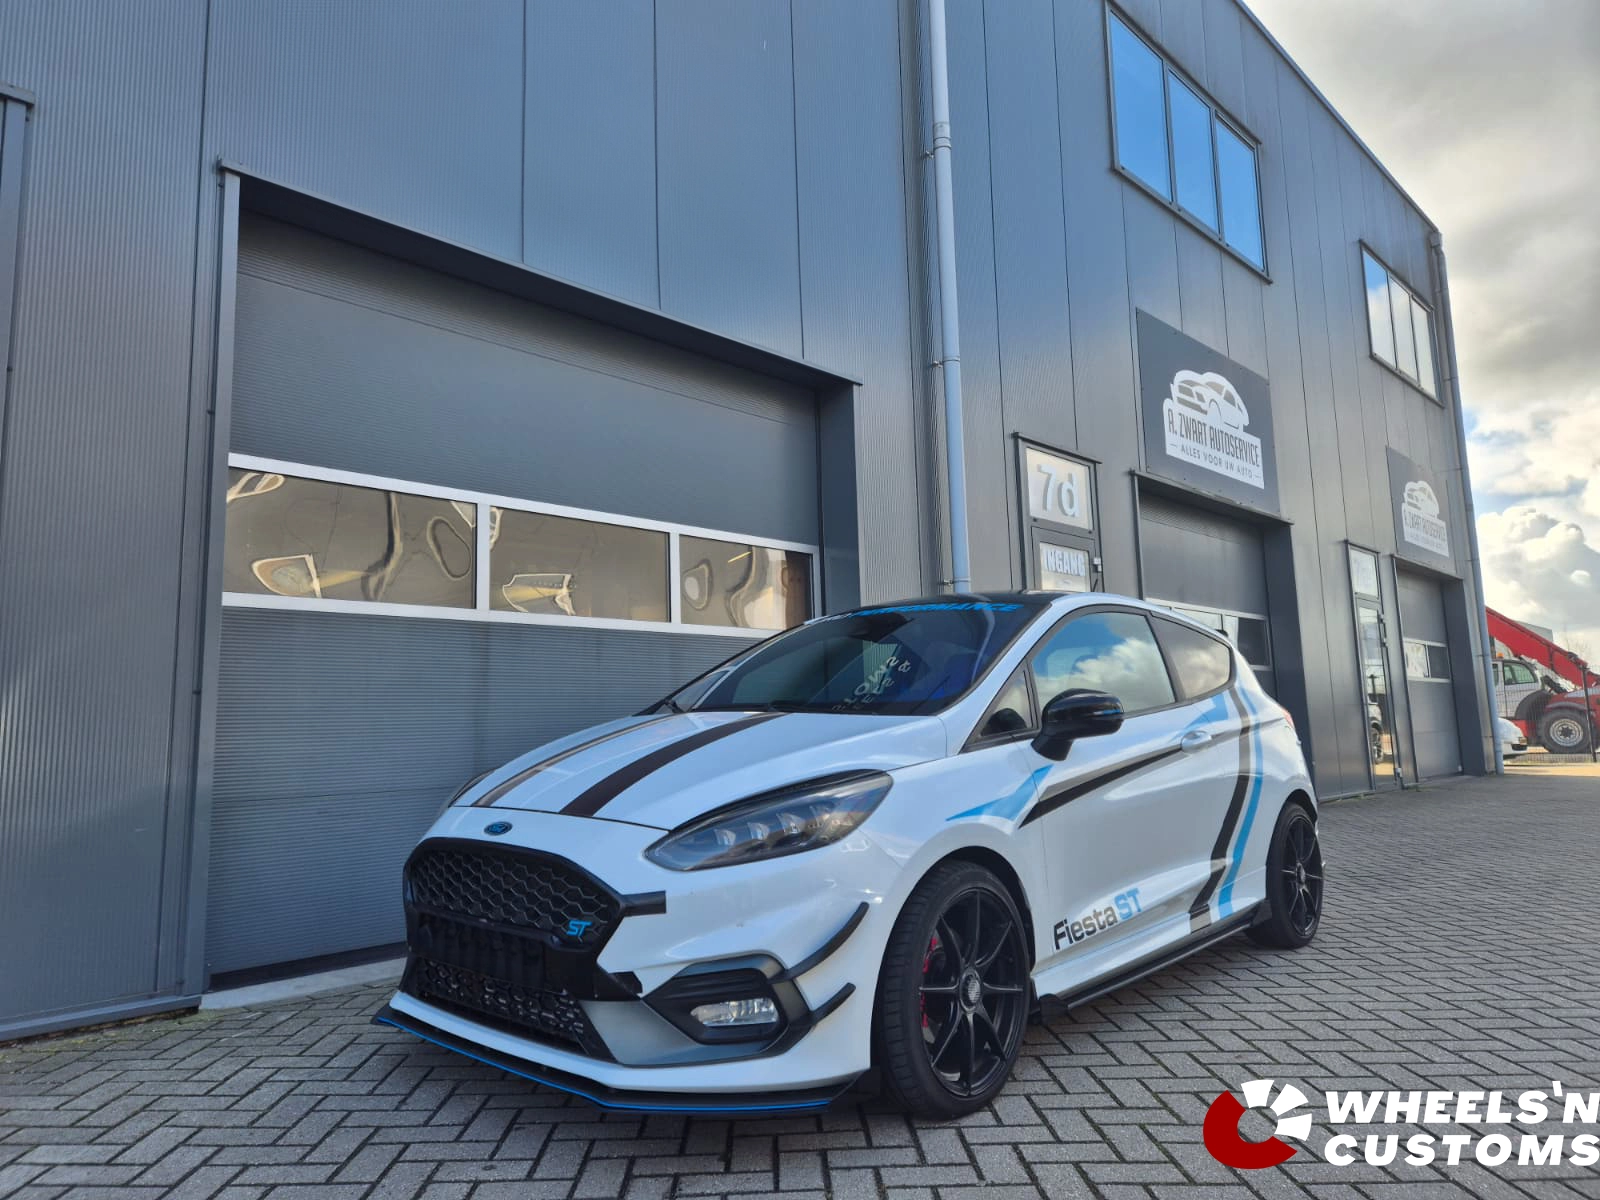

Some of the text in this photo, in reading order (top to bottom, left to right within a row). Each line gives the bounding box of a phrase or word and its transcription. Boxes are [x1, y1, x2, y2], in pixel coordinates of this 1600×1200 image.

[1168, 408, 1260, 468] A. ZWART AUTOSERVICE
[1181, 444, 1201, 460] ALLES
[1203, 452, 1222, 468] VOOR
[1225, 458, 1235, 472] UW
[1038, 463, 1080, 518] 7d
[566, 919, 592, 937] ST
